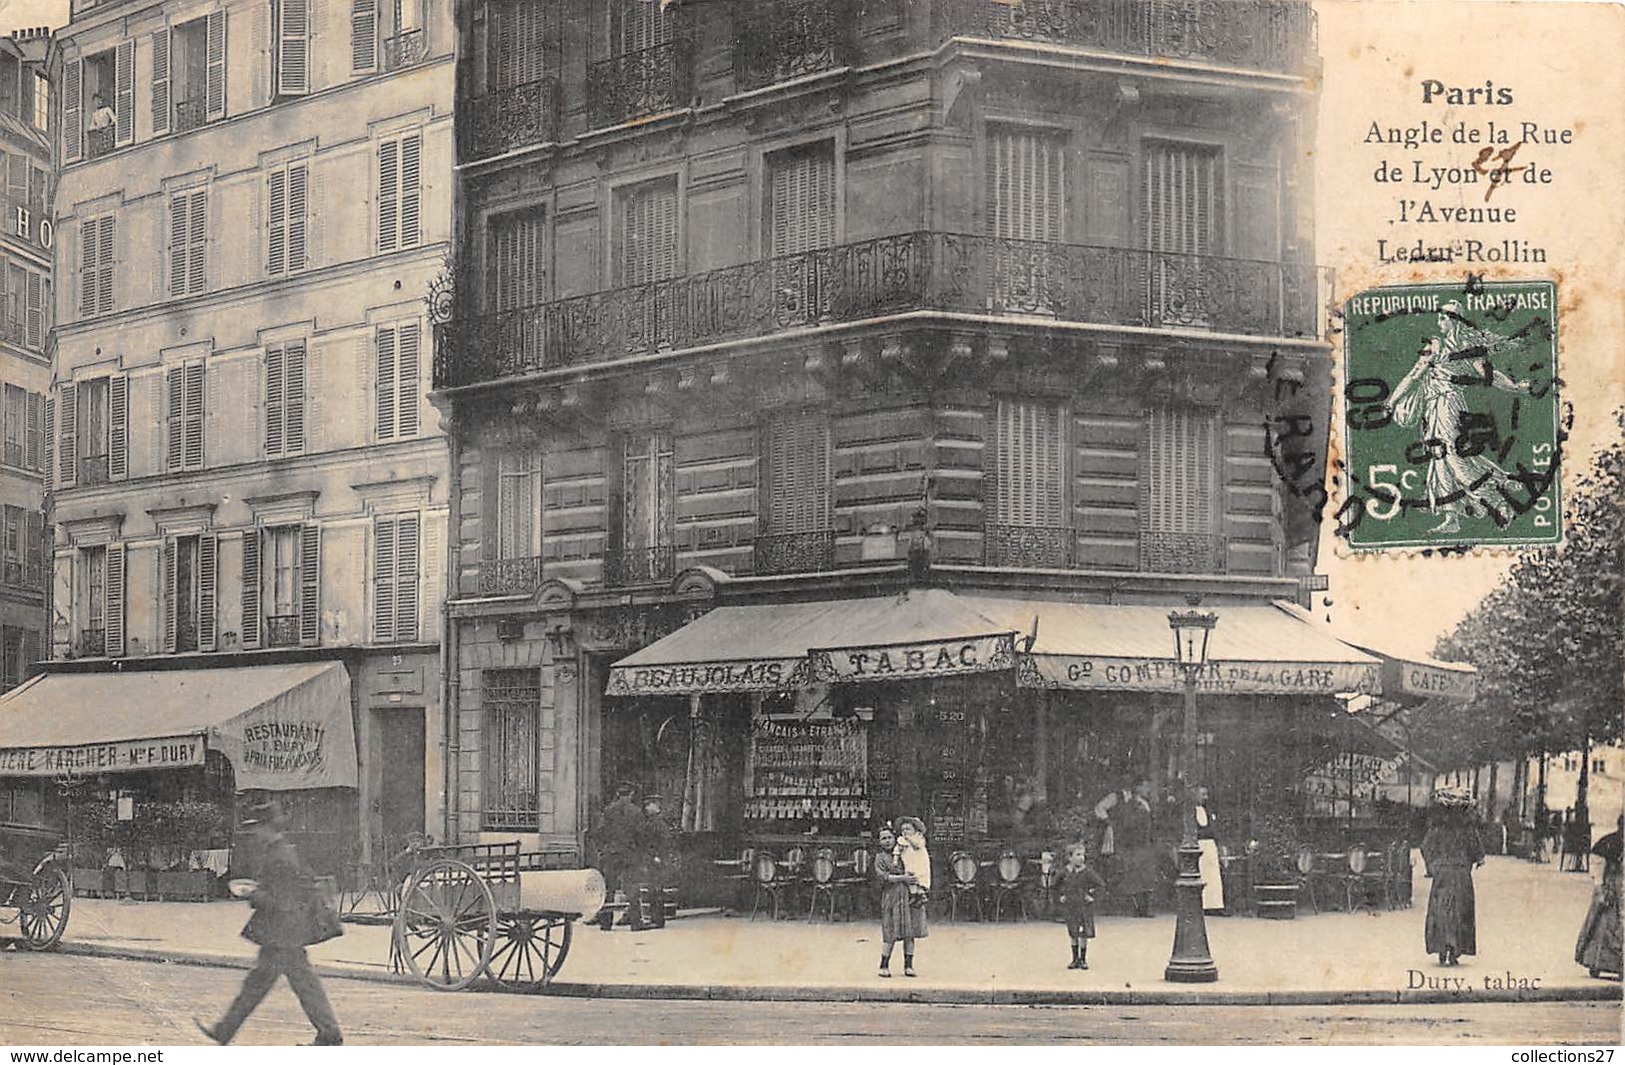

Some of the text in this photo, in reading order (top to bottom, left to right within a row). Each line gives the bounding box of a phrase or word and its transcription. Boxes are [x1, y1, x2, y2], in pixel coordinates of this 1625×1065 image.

[17, 206, 53, 249] HO
[1532, 442, 1552, 527] POES
[849, 644, 977, 674] TABAC
[633, 663, 782, 688] BEAUJOLAIS
[1105, 660, 1223, 683] COMPTIR
[1280, 669, 1335, 688] GARE
[161, 744, 196, 762] DURY
